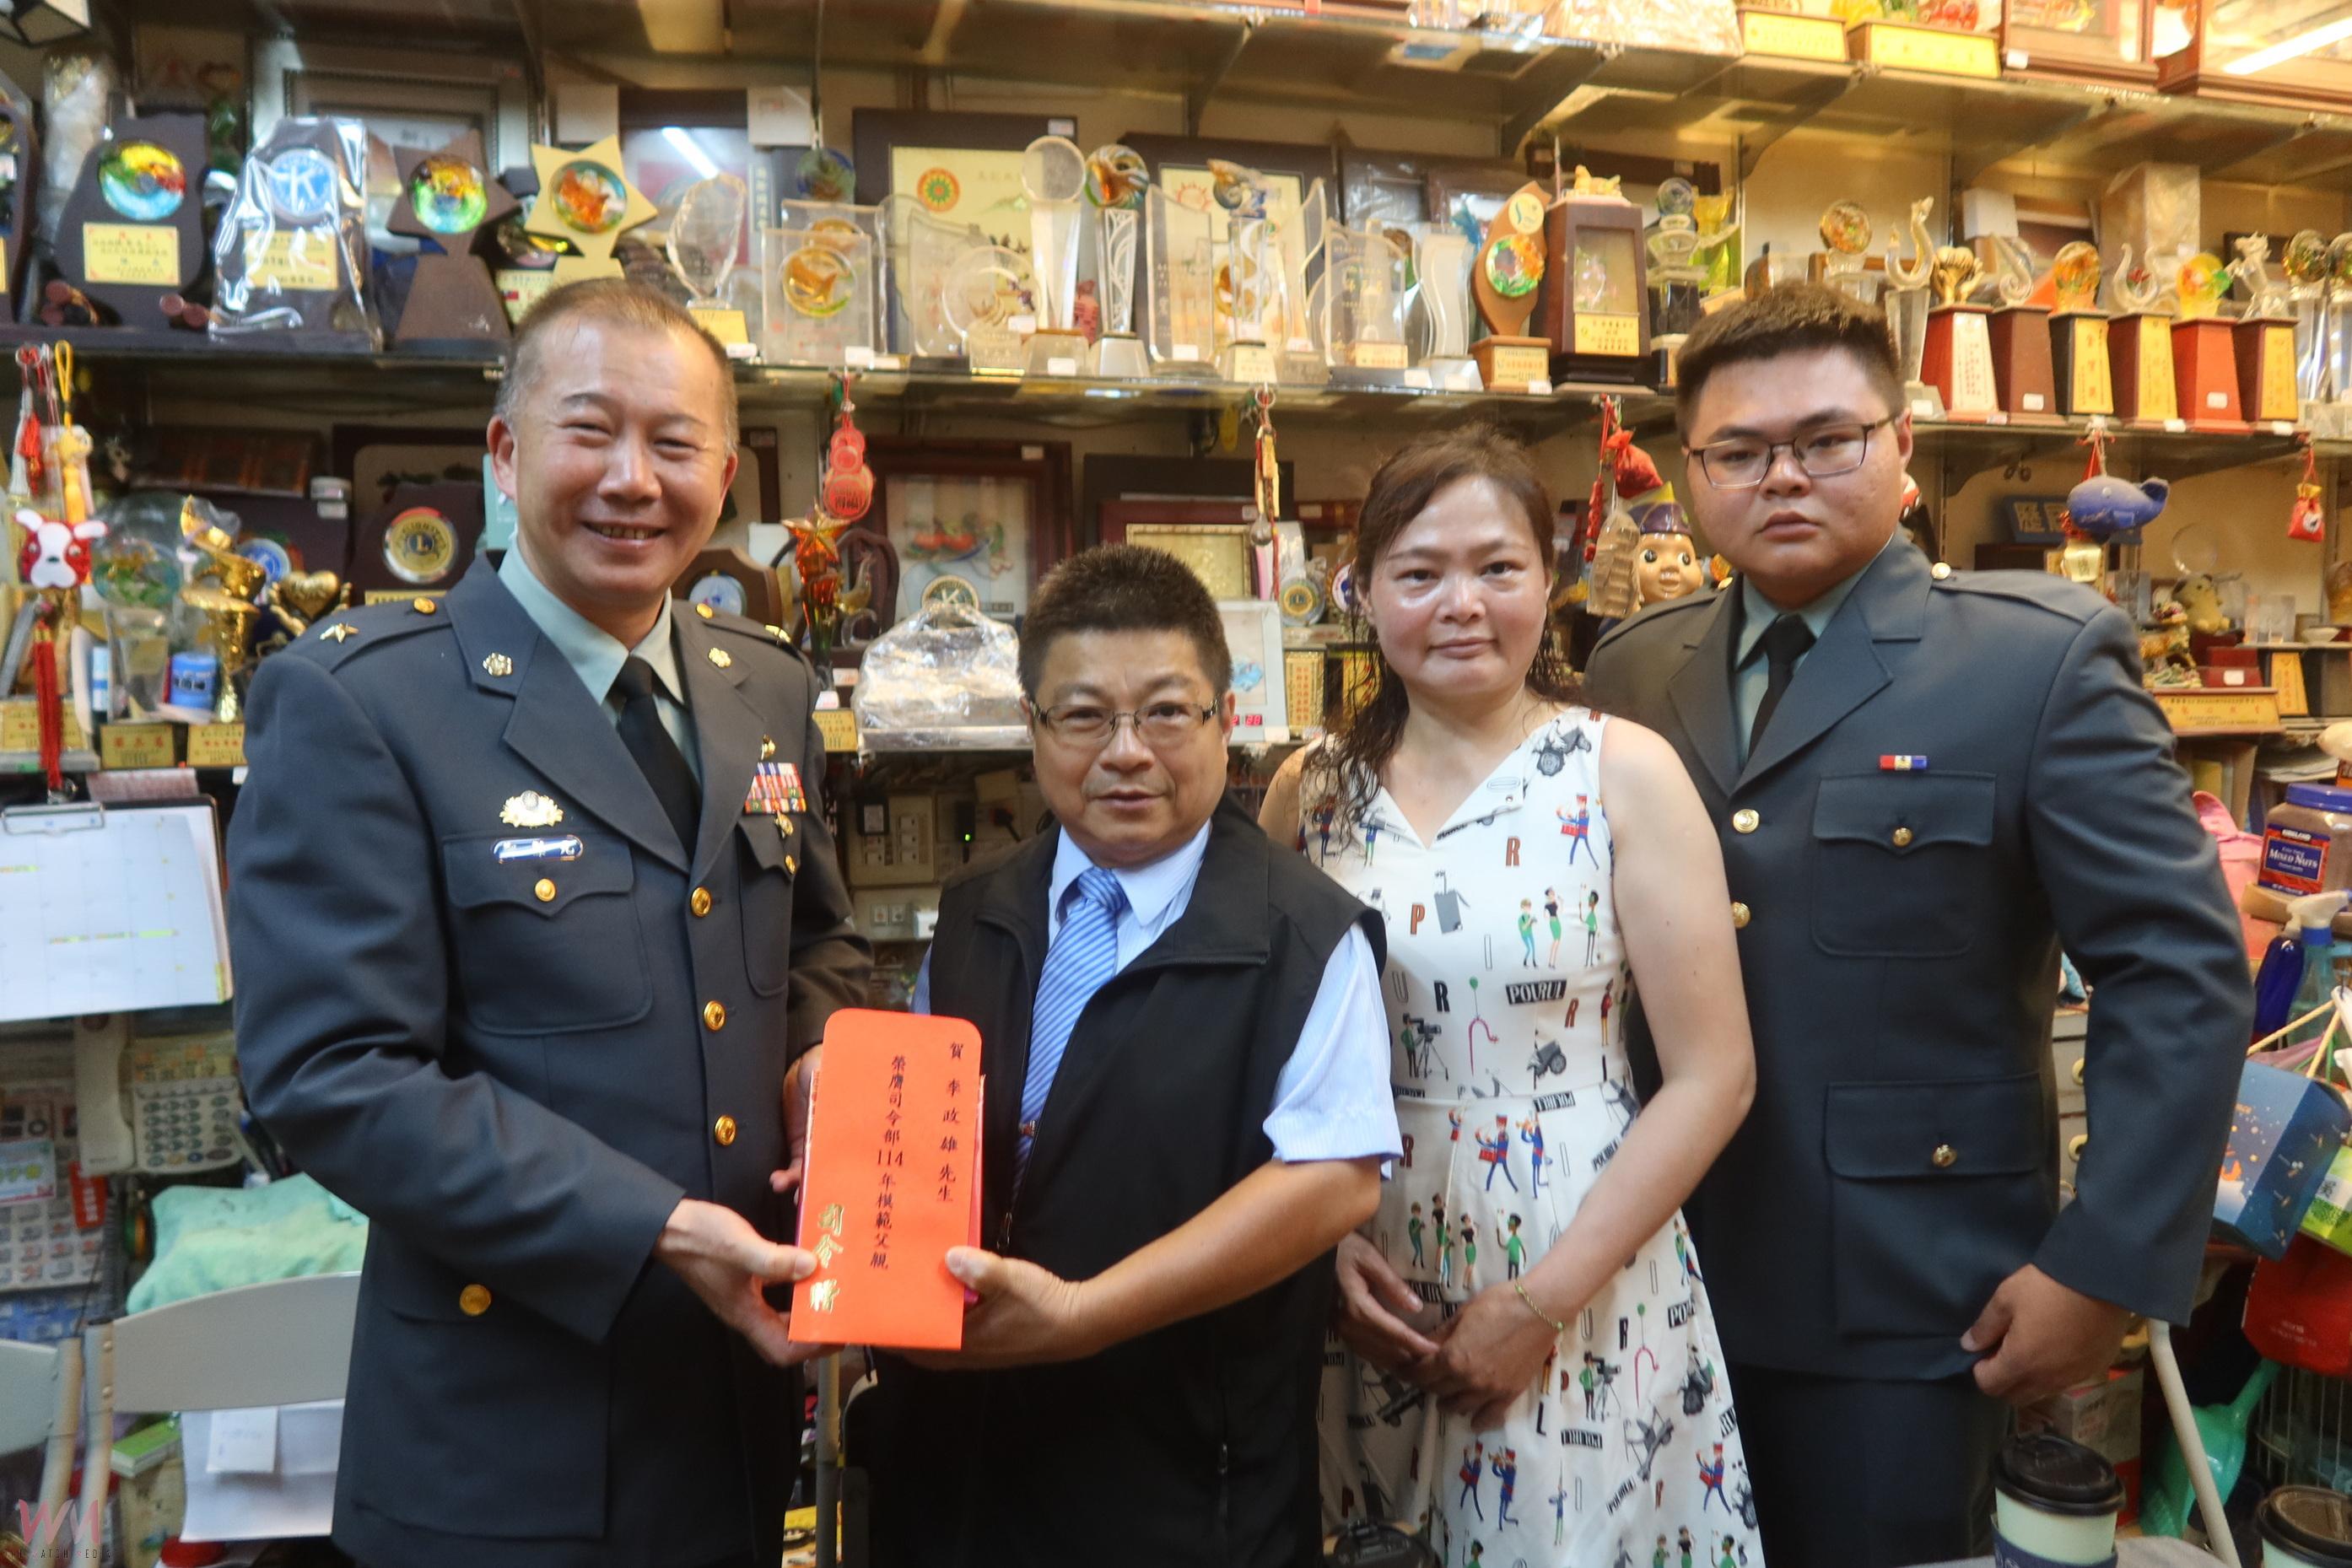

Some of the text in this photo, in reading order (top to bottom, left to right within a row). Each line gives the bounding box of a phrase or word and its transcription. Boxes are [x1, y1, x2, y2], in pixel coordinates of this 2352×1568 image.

[1506, 837, 1520, 866] R
[1411, 903, 1425, 935] P
[1434, 980, 1450, 1012] R
[1565, 998, 1579, 1027] R
[1400, 1134, 1415, 1168] R
